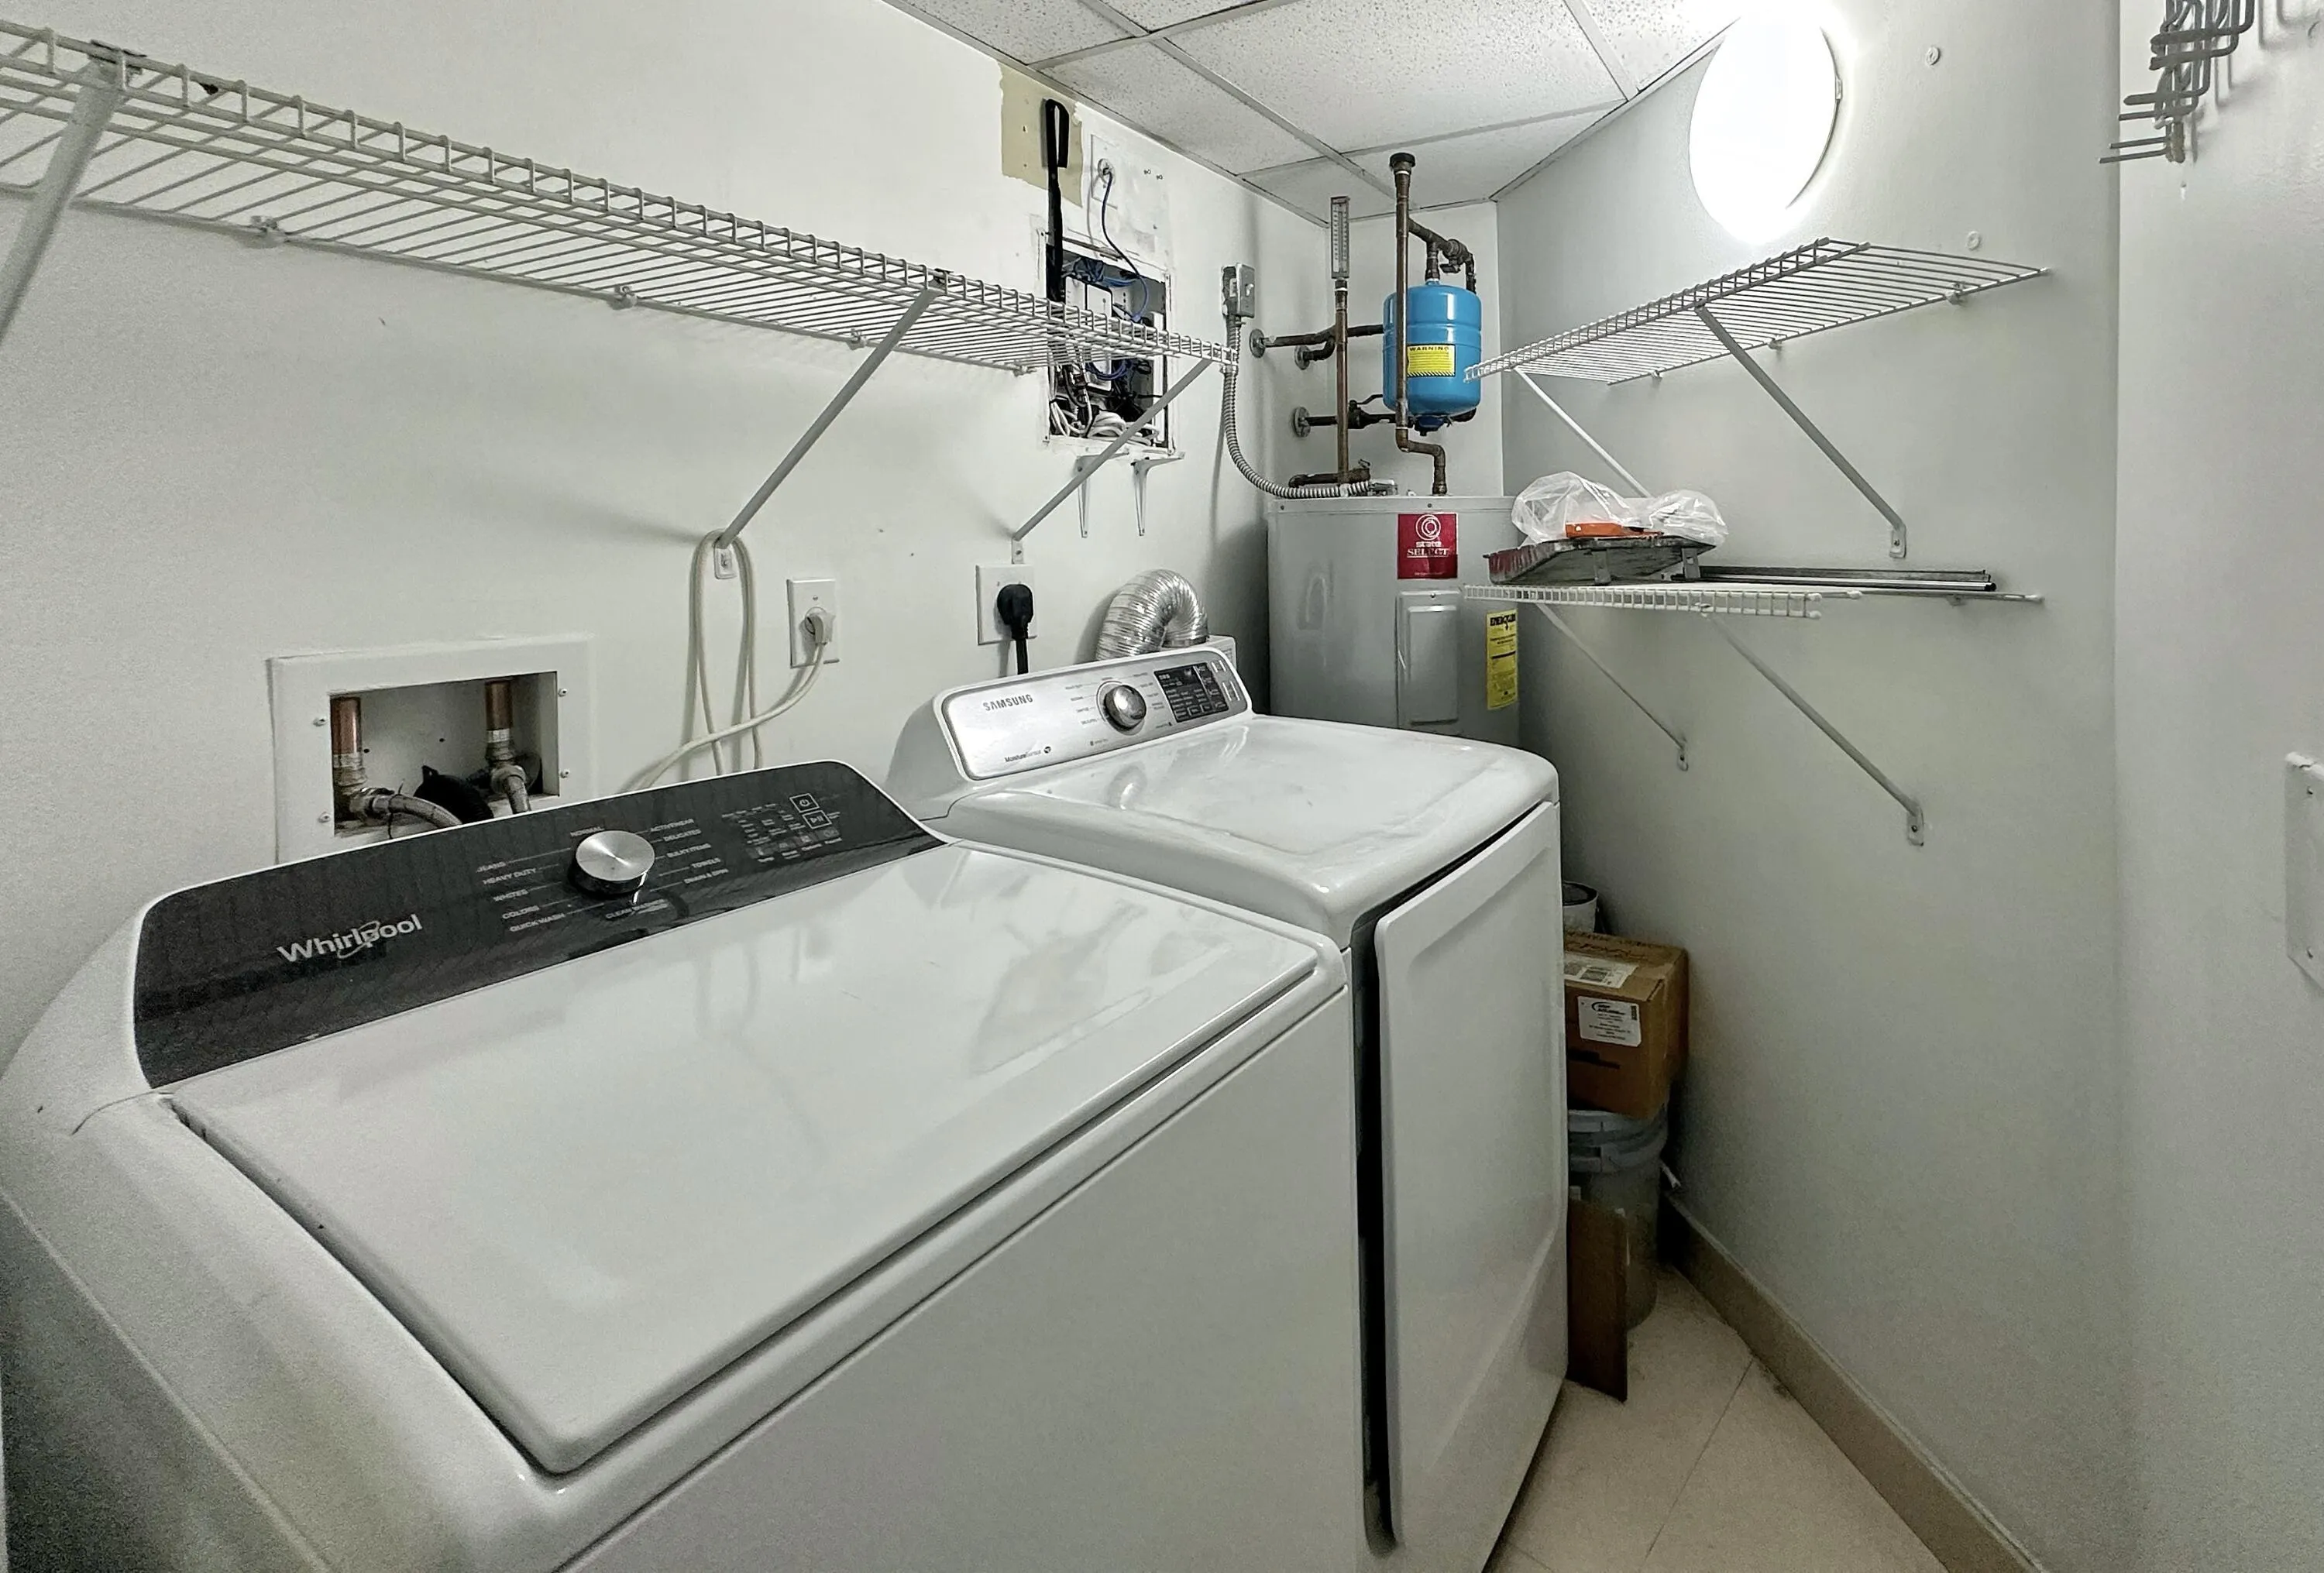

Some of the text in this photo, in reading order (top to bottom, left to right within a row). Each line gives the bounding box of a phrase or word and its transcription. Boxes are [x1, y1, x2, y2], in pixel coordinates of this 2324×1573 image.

[982, 694, 1033, 712] SAMSUNG
[483, 868, 537, 884] HEAVY DUTY
[277, 913, 423, 963] Whirlpool
